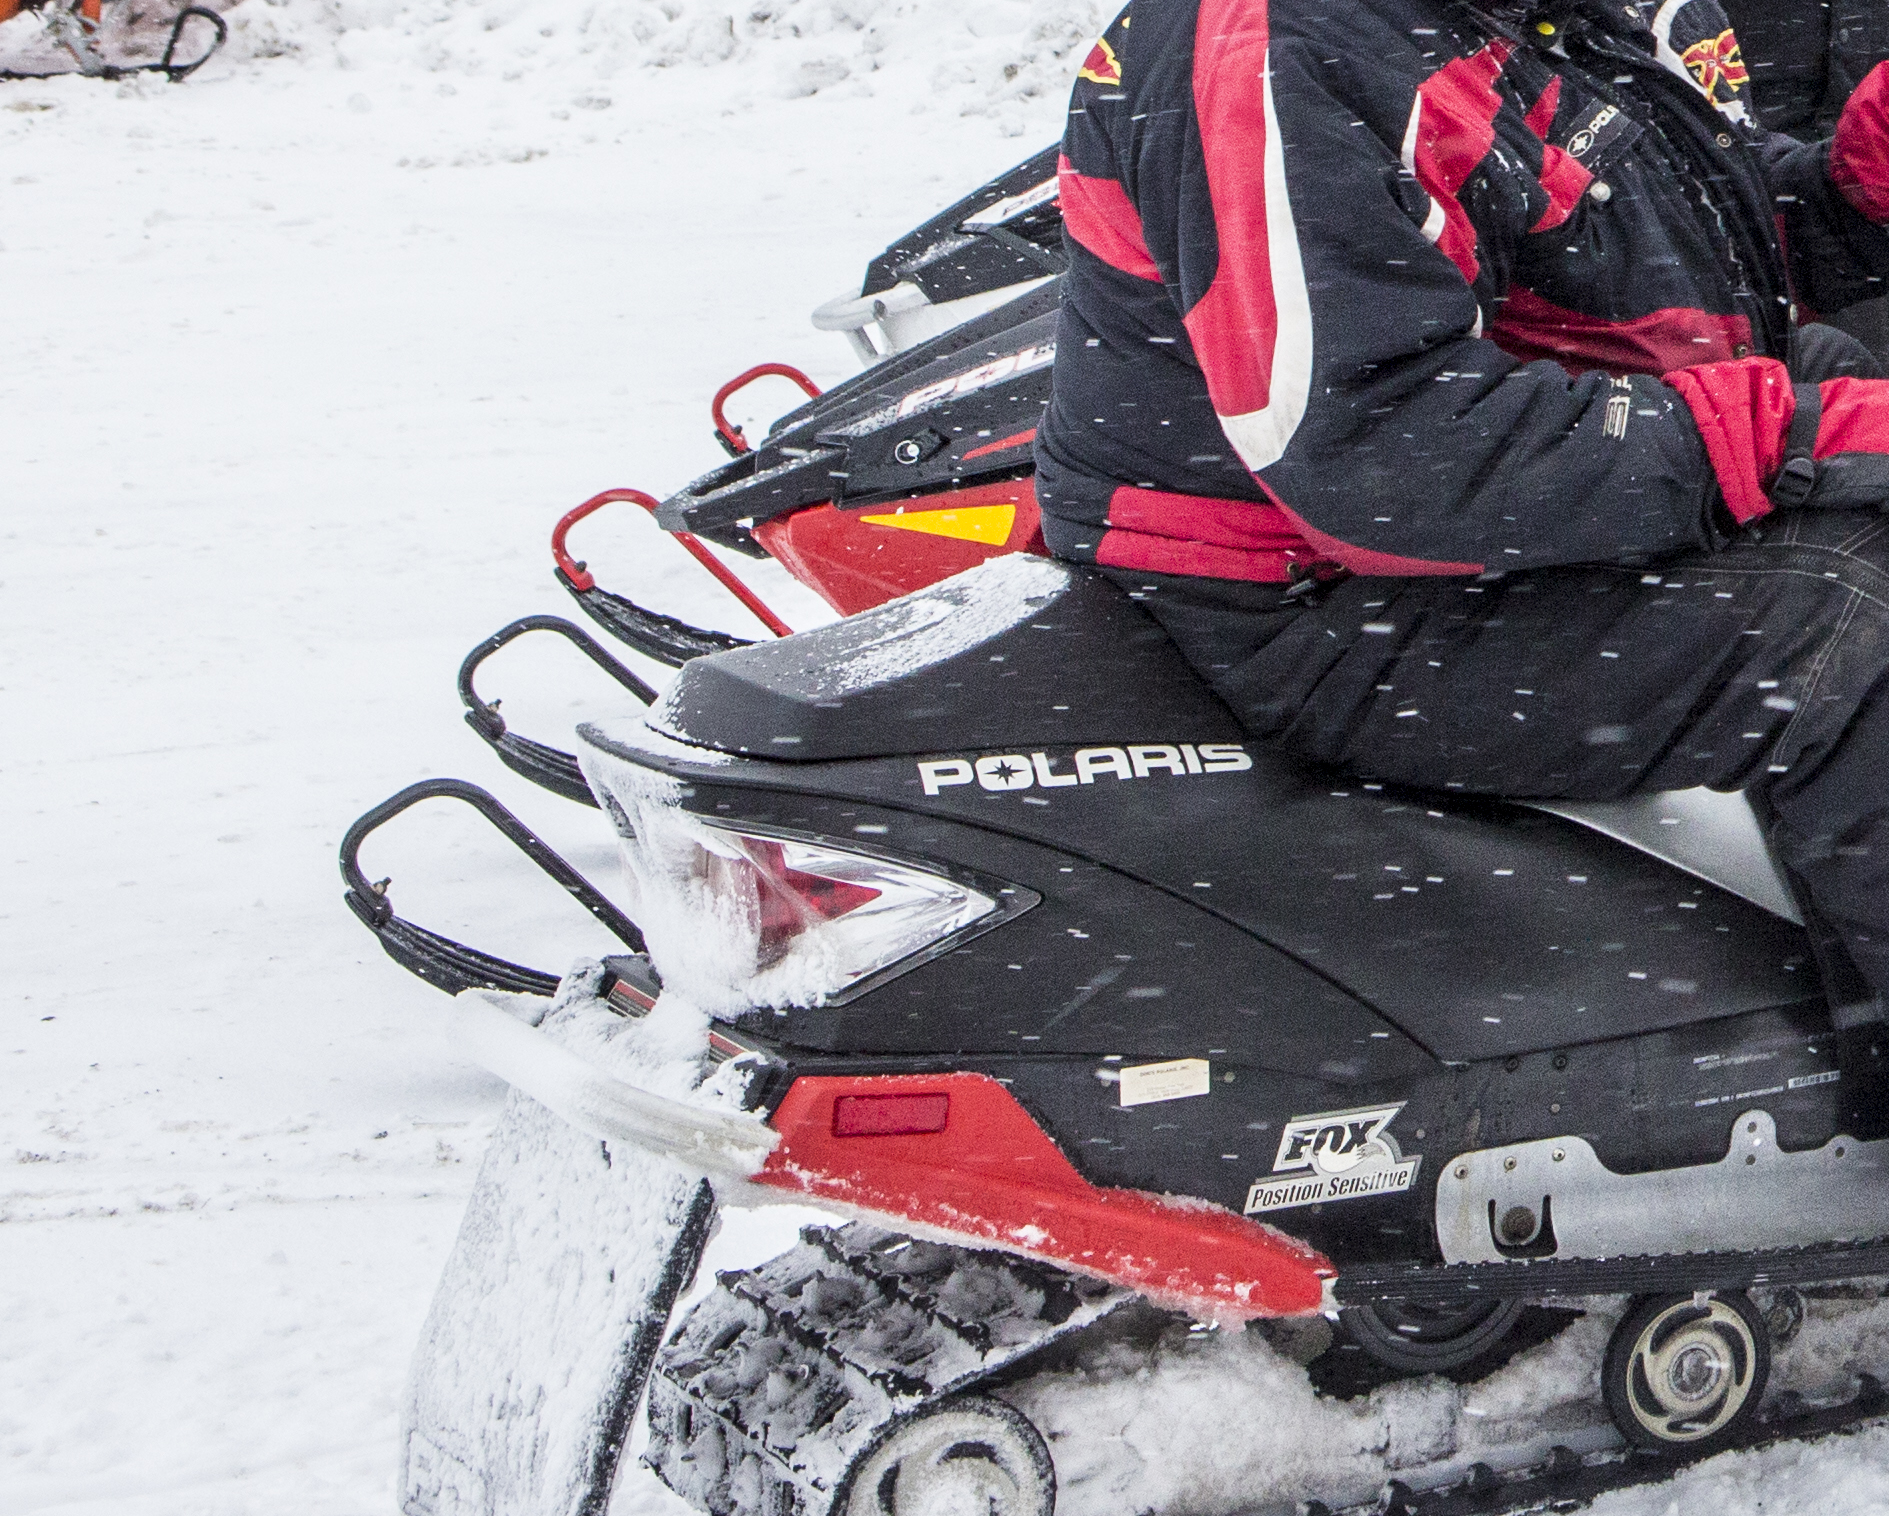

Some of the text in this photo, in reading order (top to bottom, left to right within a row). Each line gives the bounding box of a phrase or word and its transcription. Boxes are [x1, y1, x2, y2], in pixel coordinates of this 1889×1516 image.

[918, 742, 1252, 795] POLARIS
[1284, 1117, 1383, 1161] FOX
[1252, 1170, 1408, 1208] Position Sensitive
